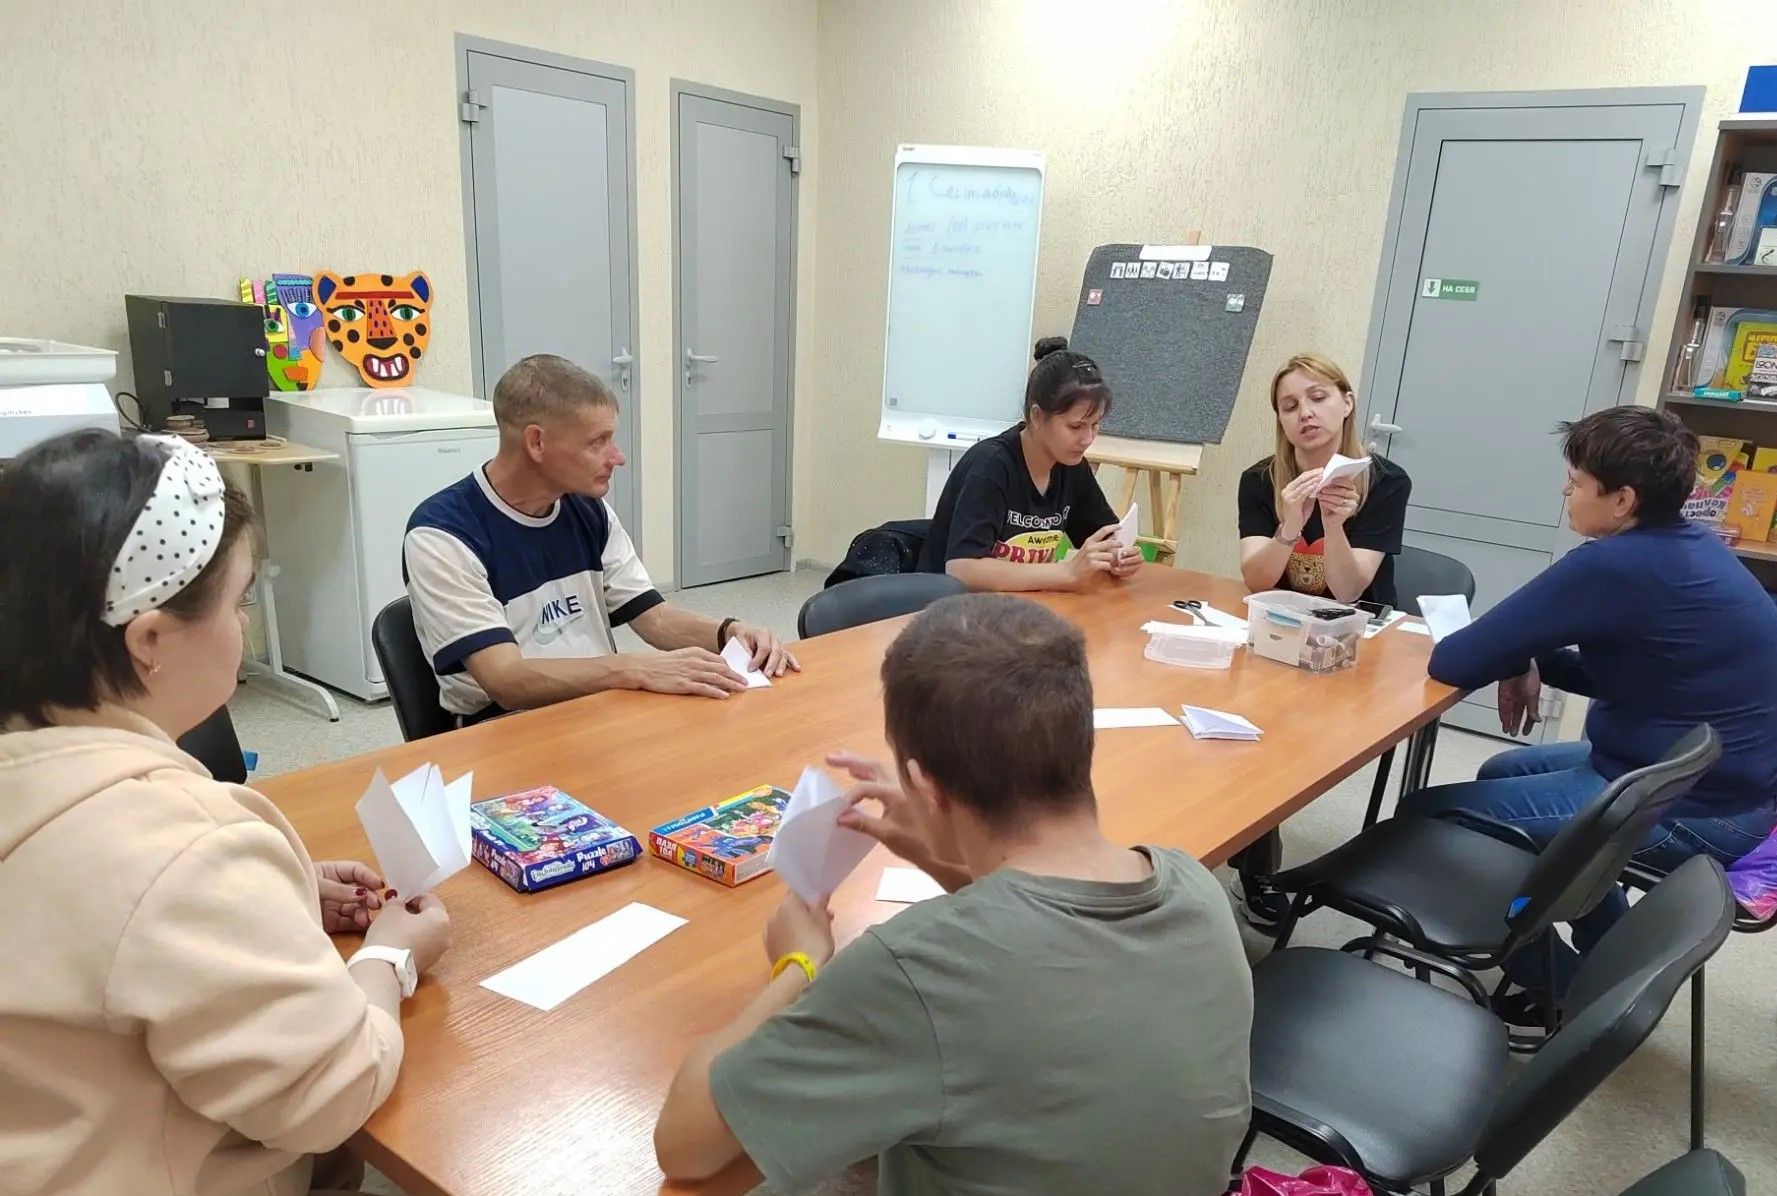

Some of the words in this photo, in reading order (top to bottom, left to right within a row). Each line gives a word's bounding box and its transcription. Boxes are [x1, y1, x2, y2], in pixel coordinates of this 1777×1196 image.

[1442, 285, 1454, 293] НА
[1455, 285, 1476, 294] СЕБЯ
[541, 594, 583, 625] NIKE
[656, 837, 677, 850] ПАЗЛ
[576, 846, 607, 863] Puzzle
[582, 859, 595, 872] 104
